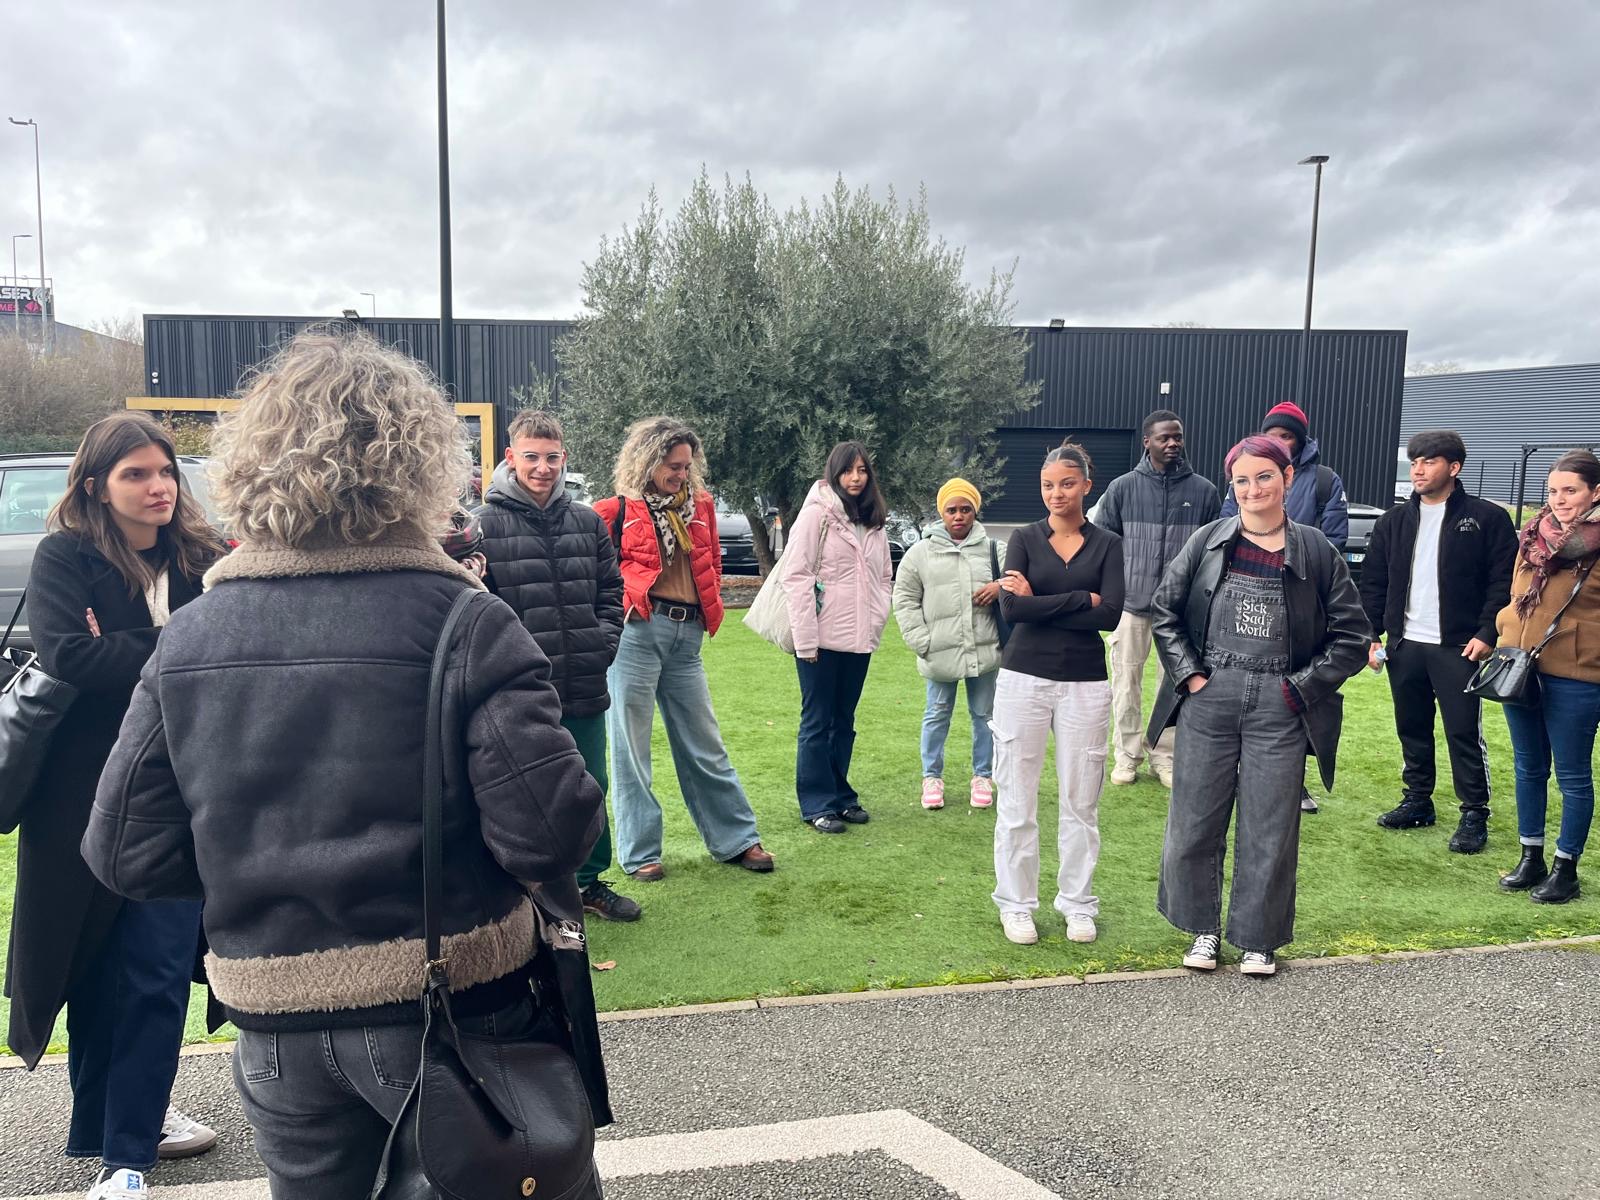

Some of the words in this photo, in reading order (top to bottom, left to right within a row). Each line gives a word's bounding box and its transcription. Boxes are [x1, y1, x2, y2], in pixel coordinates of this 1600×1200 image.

[0, 287, 31, 301] SER
[1242, 599, 1267, 614] Sick
[1242, 611, 1265, 626] Sad
[1235, 621, 1270, 638] World
